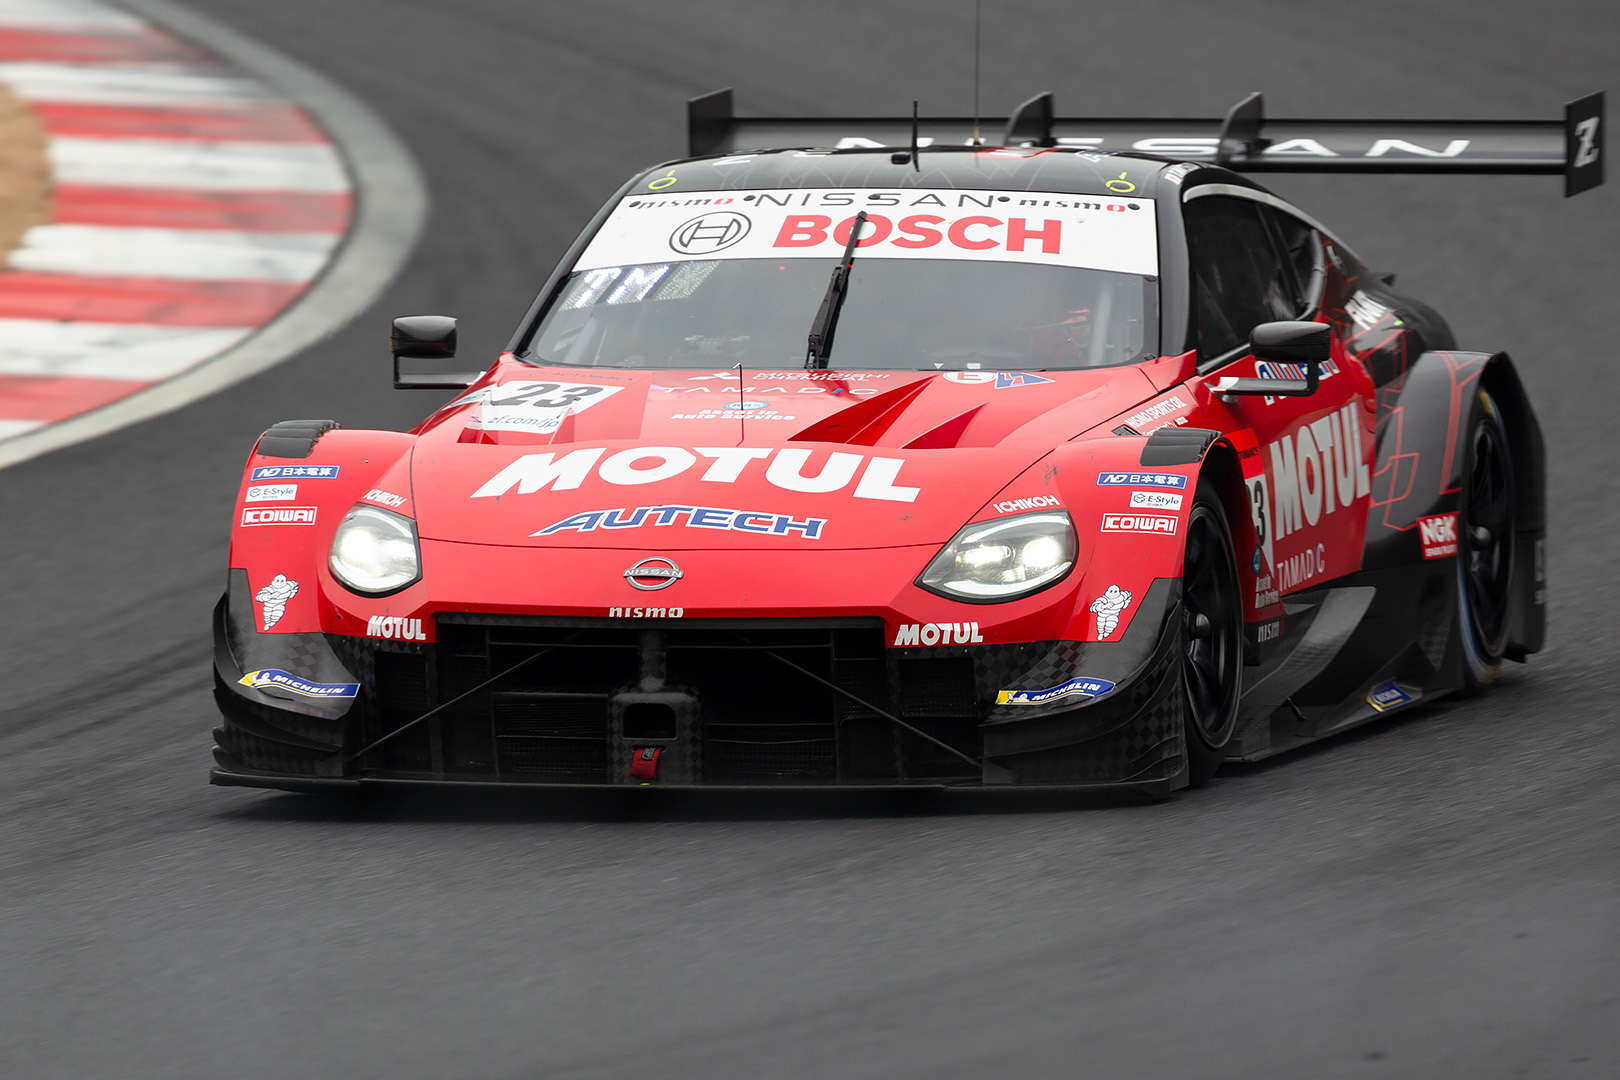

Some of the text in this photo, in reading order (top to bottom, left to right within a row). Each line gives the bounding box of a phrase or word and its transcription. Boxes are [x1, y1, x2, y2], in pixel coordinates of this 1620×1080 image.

[836, 137, 1471, 157] NSAN
[637, 197, 734, 210] nismo
[754, 192, 994, 208] NISSAN
[1018, 198, 1126, 212] nismo
[772, 213, 1062, 255] BOSCH
[490, 383, 604, 408] 23
[662, 386, 879, 395] TAMADIC
[487, 414, 560, 429] zf.com/jp
[282, 467, 333, 477] 日本電算
[469, 446, 922, 503] MOTUL
[1129, 474, 1180, 486] 日本電算
[1269, 401, 1371, 541] MOTUL
[263, 487, 294, 496] E-Style
[363, 489, 407, 508] ICHIKOH
[1147, 495, 1180, 506] E-Style
[993, 495, 1061, 514] ICHIKOH
[1246, 480, 1266, 547] 3
[244, 510, 314, 523] KOIWAI
[528, 504, 828, 540] AUTECH
[1104, 516, 1176, 532] KOIWAI
[1420, 515, 1457, 545] NGK
[624, 568, 683, 578] NISSAN
[609, 607, 684, 618] nismo
[366, 615, 427, 641] MOTUL
[894, 621, 984, 646] MOTUL
[272, 674, 346, 695] MICHELIN
[1031, 682, 1102, 702] MICHELIN
